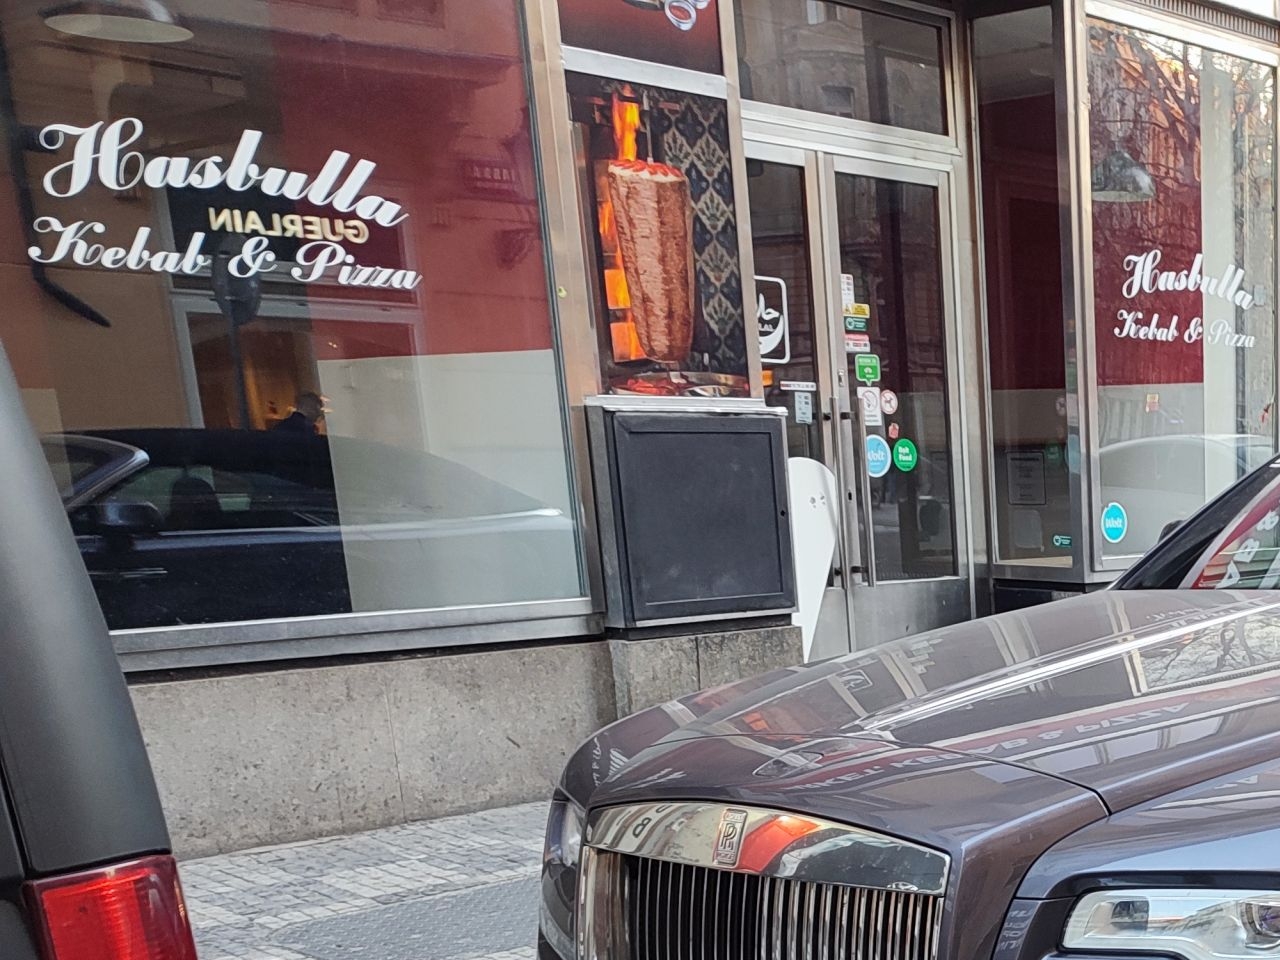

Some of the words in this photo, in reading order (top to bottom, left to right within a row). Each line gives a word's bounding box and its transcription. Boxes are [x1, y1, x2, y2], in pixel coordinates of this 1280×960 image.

[39, 117, 410, 228] Hasbulla
[27, 216, 211, 275] Kebab
[227, 236, 278, 278] &
[291, 240, 422, 290] Pizza
[1122, 249, 1255, 310] Hasbulla
[1113, 309, 1179, 342] Kebab
[1184, 317, 1204, 343] &
[1207, 319, 1256, 348] Pizza
[1105, 517, 1123, 529] Wolt
